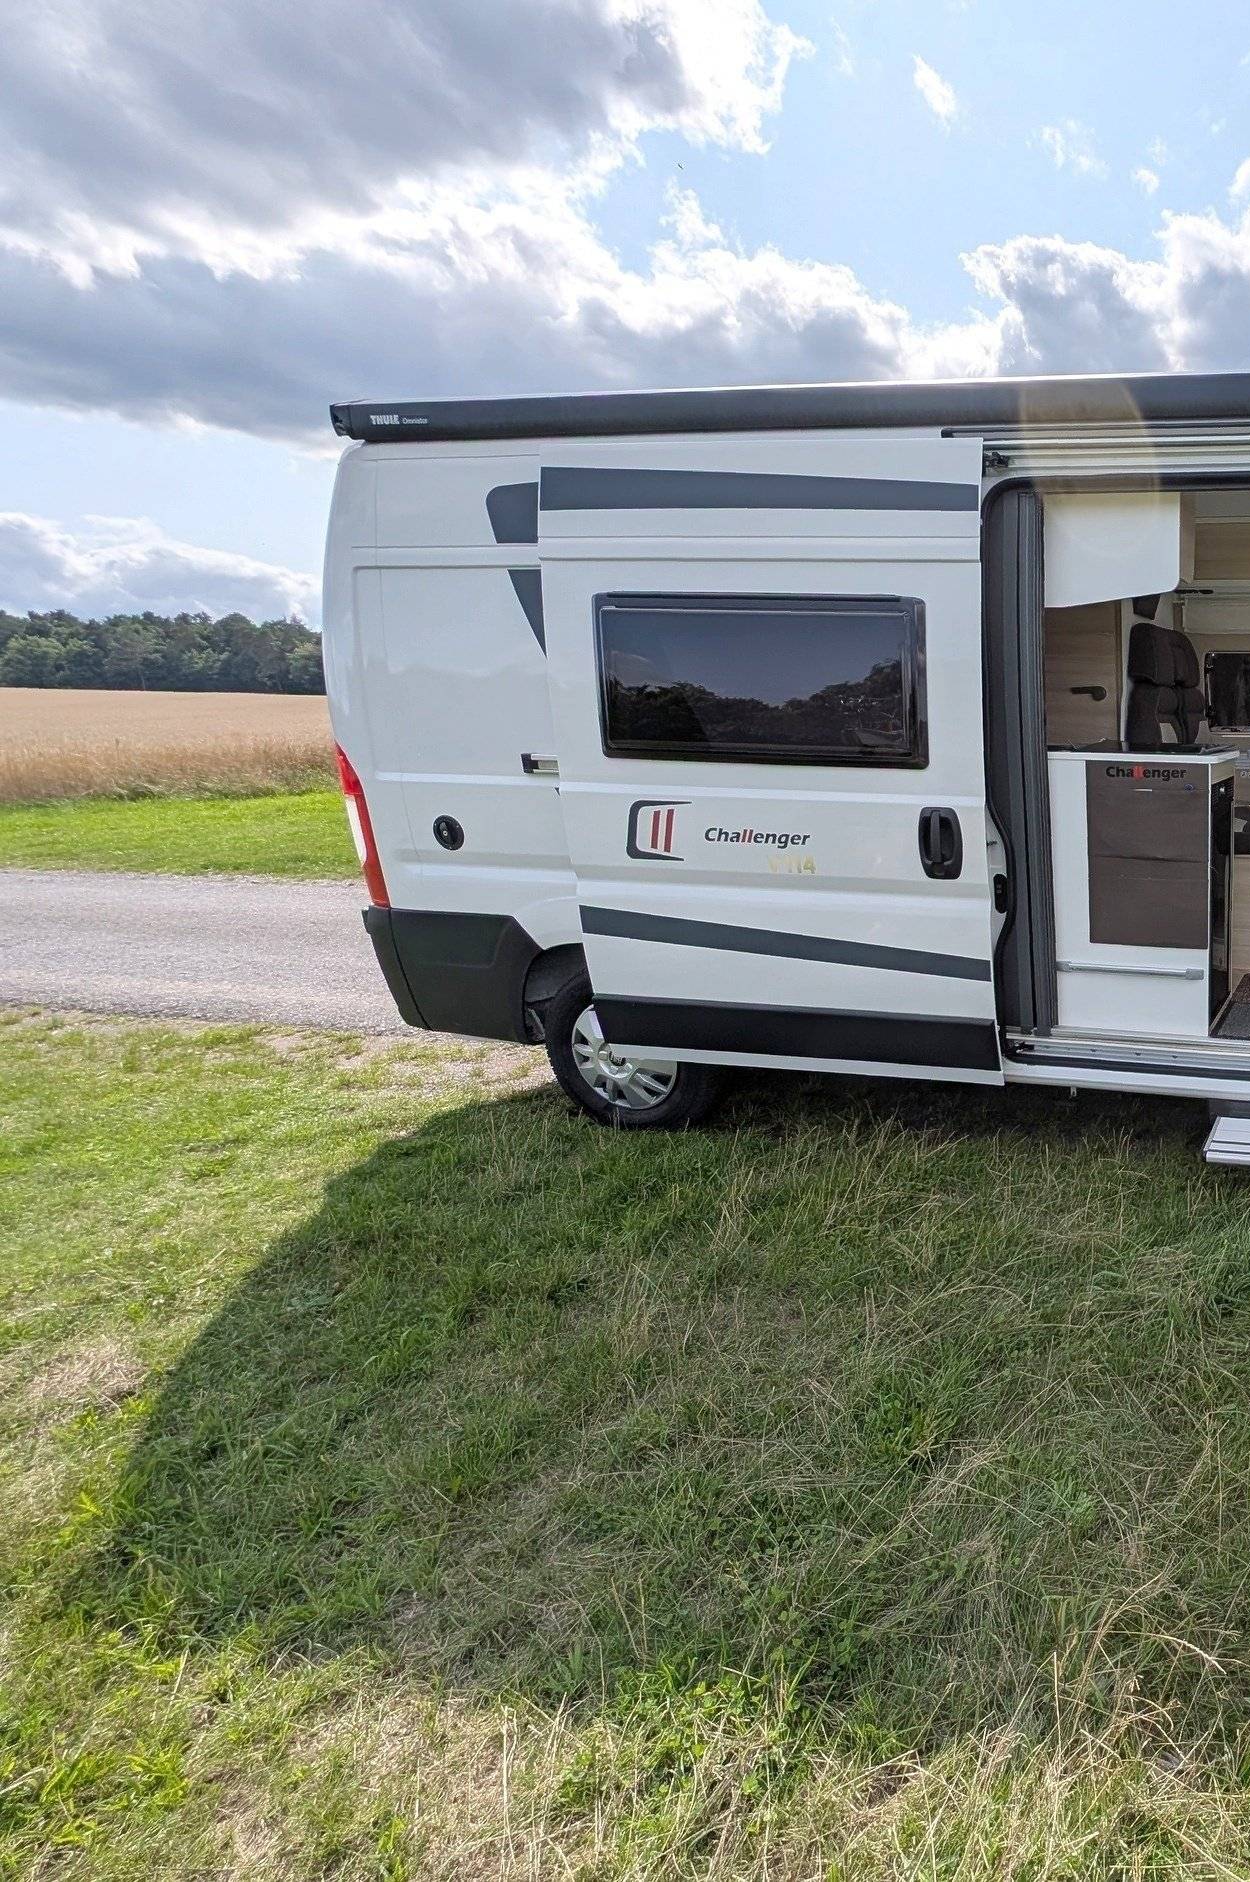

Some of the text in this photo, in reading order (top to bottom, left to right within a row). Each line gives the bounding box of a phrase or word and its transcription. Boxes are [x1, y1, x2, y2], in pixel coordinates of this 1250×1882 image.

[370, 414, 400, 425] THULE
[1106, 766, 1187, 781] Challenger
[704, 827, 811, 849] Challenger
